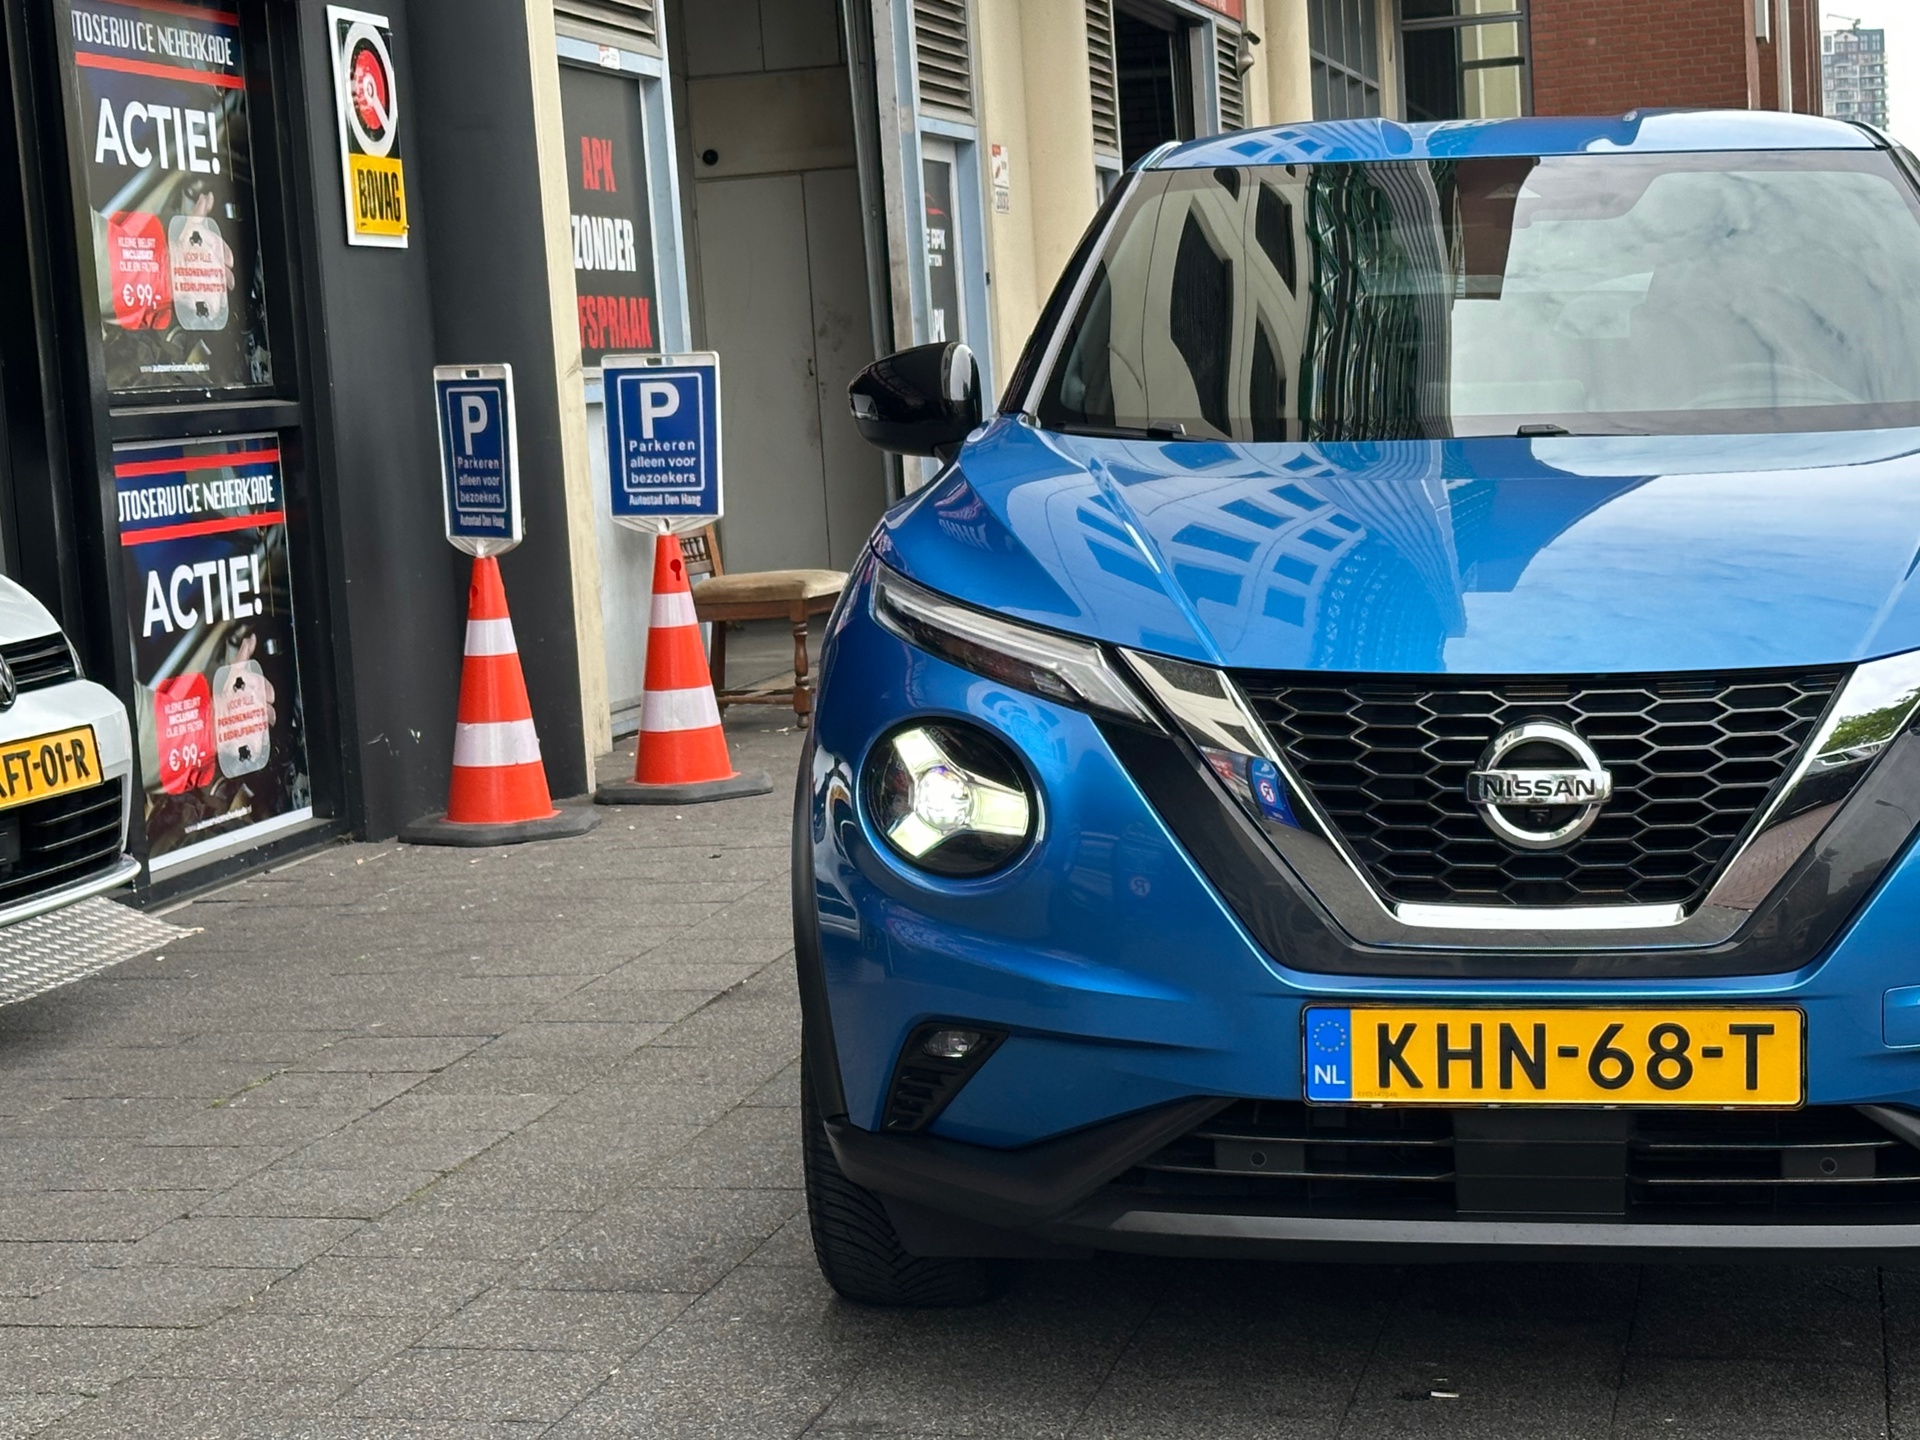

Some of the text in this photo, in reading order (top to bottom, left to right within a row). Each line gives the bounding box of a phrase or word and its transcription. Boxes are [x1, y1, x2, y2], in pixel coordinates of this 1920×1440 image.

[157, 25, 234, 66] NEHERKADE
[95, 97, 221, 175] ACTIE!
[581, 136, 617, 193] APK
[357, 168, 401, 223] BOVAG
[571, 214, 637, 272] ZONDER
[578, 295, 653, 349] FSPRAAK
[461, 395, 488, 456] P
[640, 382, 680, 439] P
[457, 456, 500, 470] Parkeren
[629, 439, 696, 452] Parkeren
[630, 455, 697, 468] alleen voor
[202, 475, 275, 511] NEHERKADE
[459, 474, 501, 487] alleen voor
[460, 491, 502, 504] bezoekers
[629, 493, 702, 507] Autostad Den Haag
[631, 471, 697, 485] bezoekers
[143, 553, 263, 638] ACTIE!
[0, 738, 91, 798] FT-01-R
[1484, 778, 1595, 797] NISSAN
[1314, 1022, 1775, 1091] NL KHN-68-T
